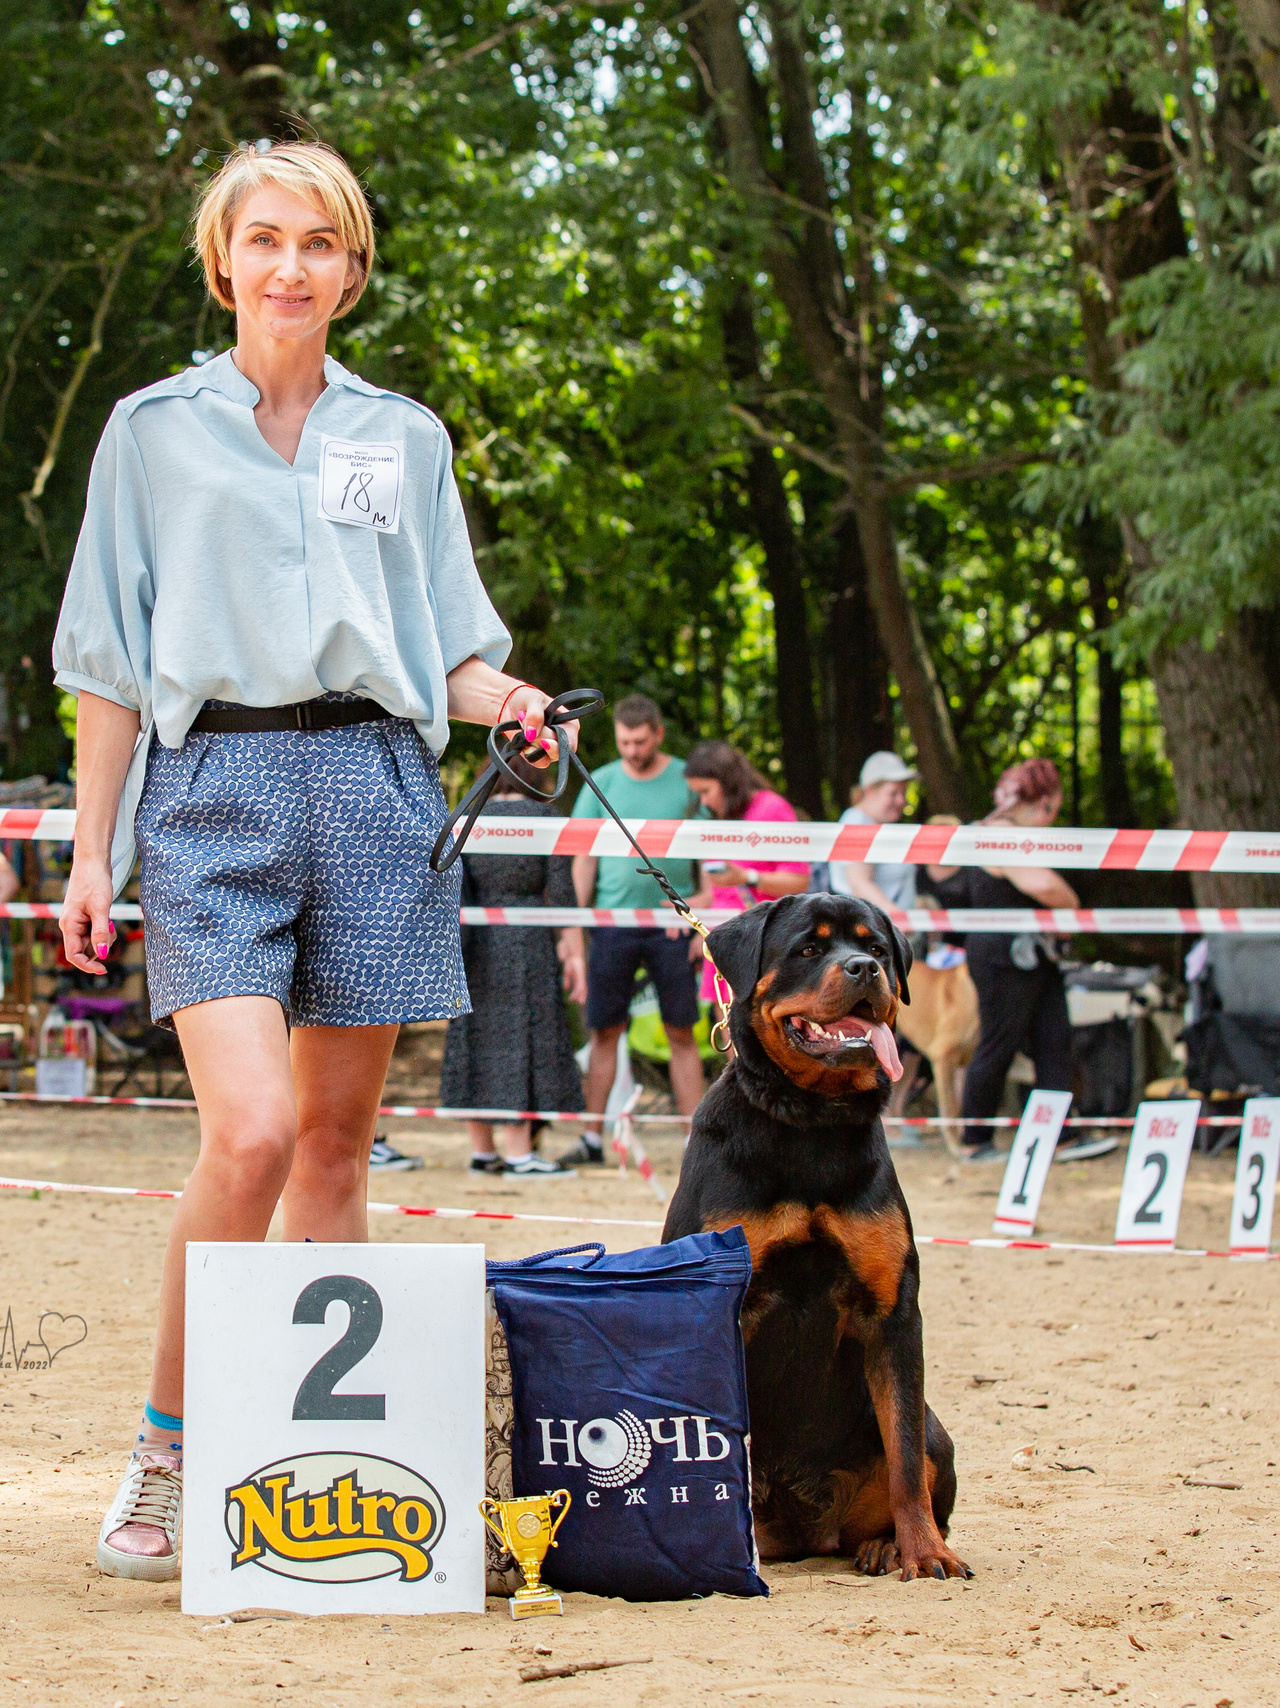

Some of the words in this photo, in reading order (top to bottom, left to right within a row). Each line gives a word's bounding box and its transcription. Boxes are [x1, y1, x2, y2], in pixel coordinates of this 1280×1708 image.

[340, 471, 374, 513] 18
[486, 828, 535, 838] ВОСТОК
[700, 833, 744, 843] СЕРВИС
[761, 835, 810, 845] ВОСТОК
[974, 841, 1018, 851] СЕРВИС
[1036, 842, 1083, 852] ВОСТОК
[1011, 1136, 1040, 1206] 1
[1133, 1152, 1169, 1224] 2
[1241, 1152, 1265, 1231] 3
[291, 1274, 387, 1421] 2
[535, 1415, 732, 1469] НОЧЬ
[228, 1473, 434, 1568] Nutro
